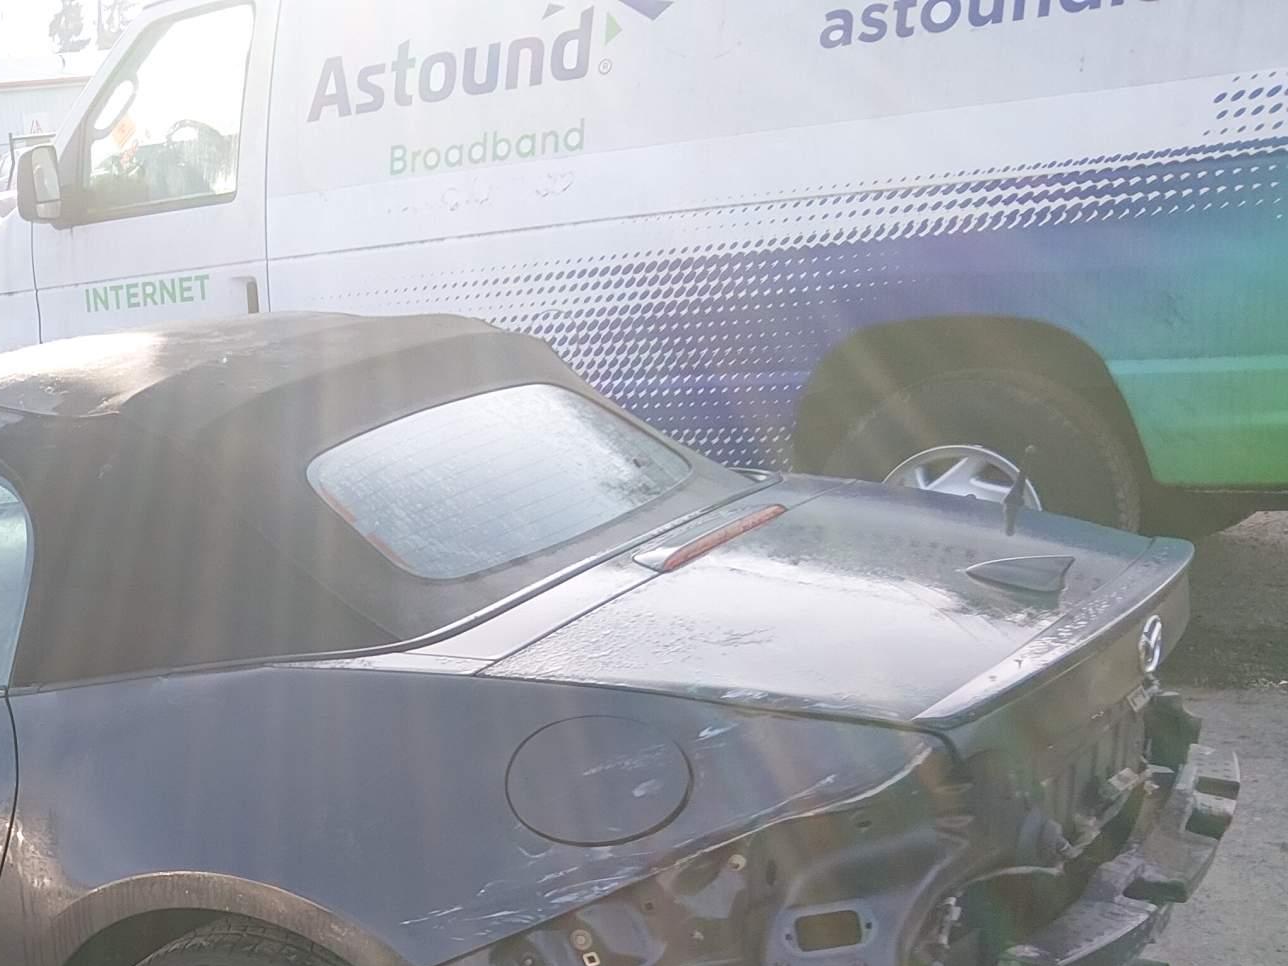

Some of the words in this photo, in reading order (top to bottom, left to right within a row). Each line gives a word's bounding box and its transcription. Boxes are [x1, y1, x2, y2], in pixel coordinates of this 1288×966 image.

[307, 6, 594, 122] Astound
[389, 117, 585, 176] Broadband
[84, 274, 210, 313] INTERNET
